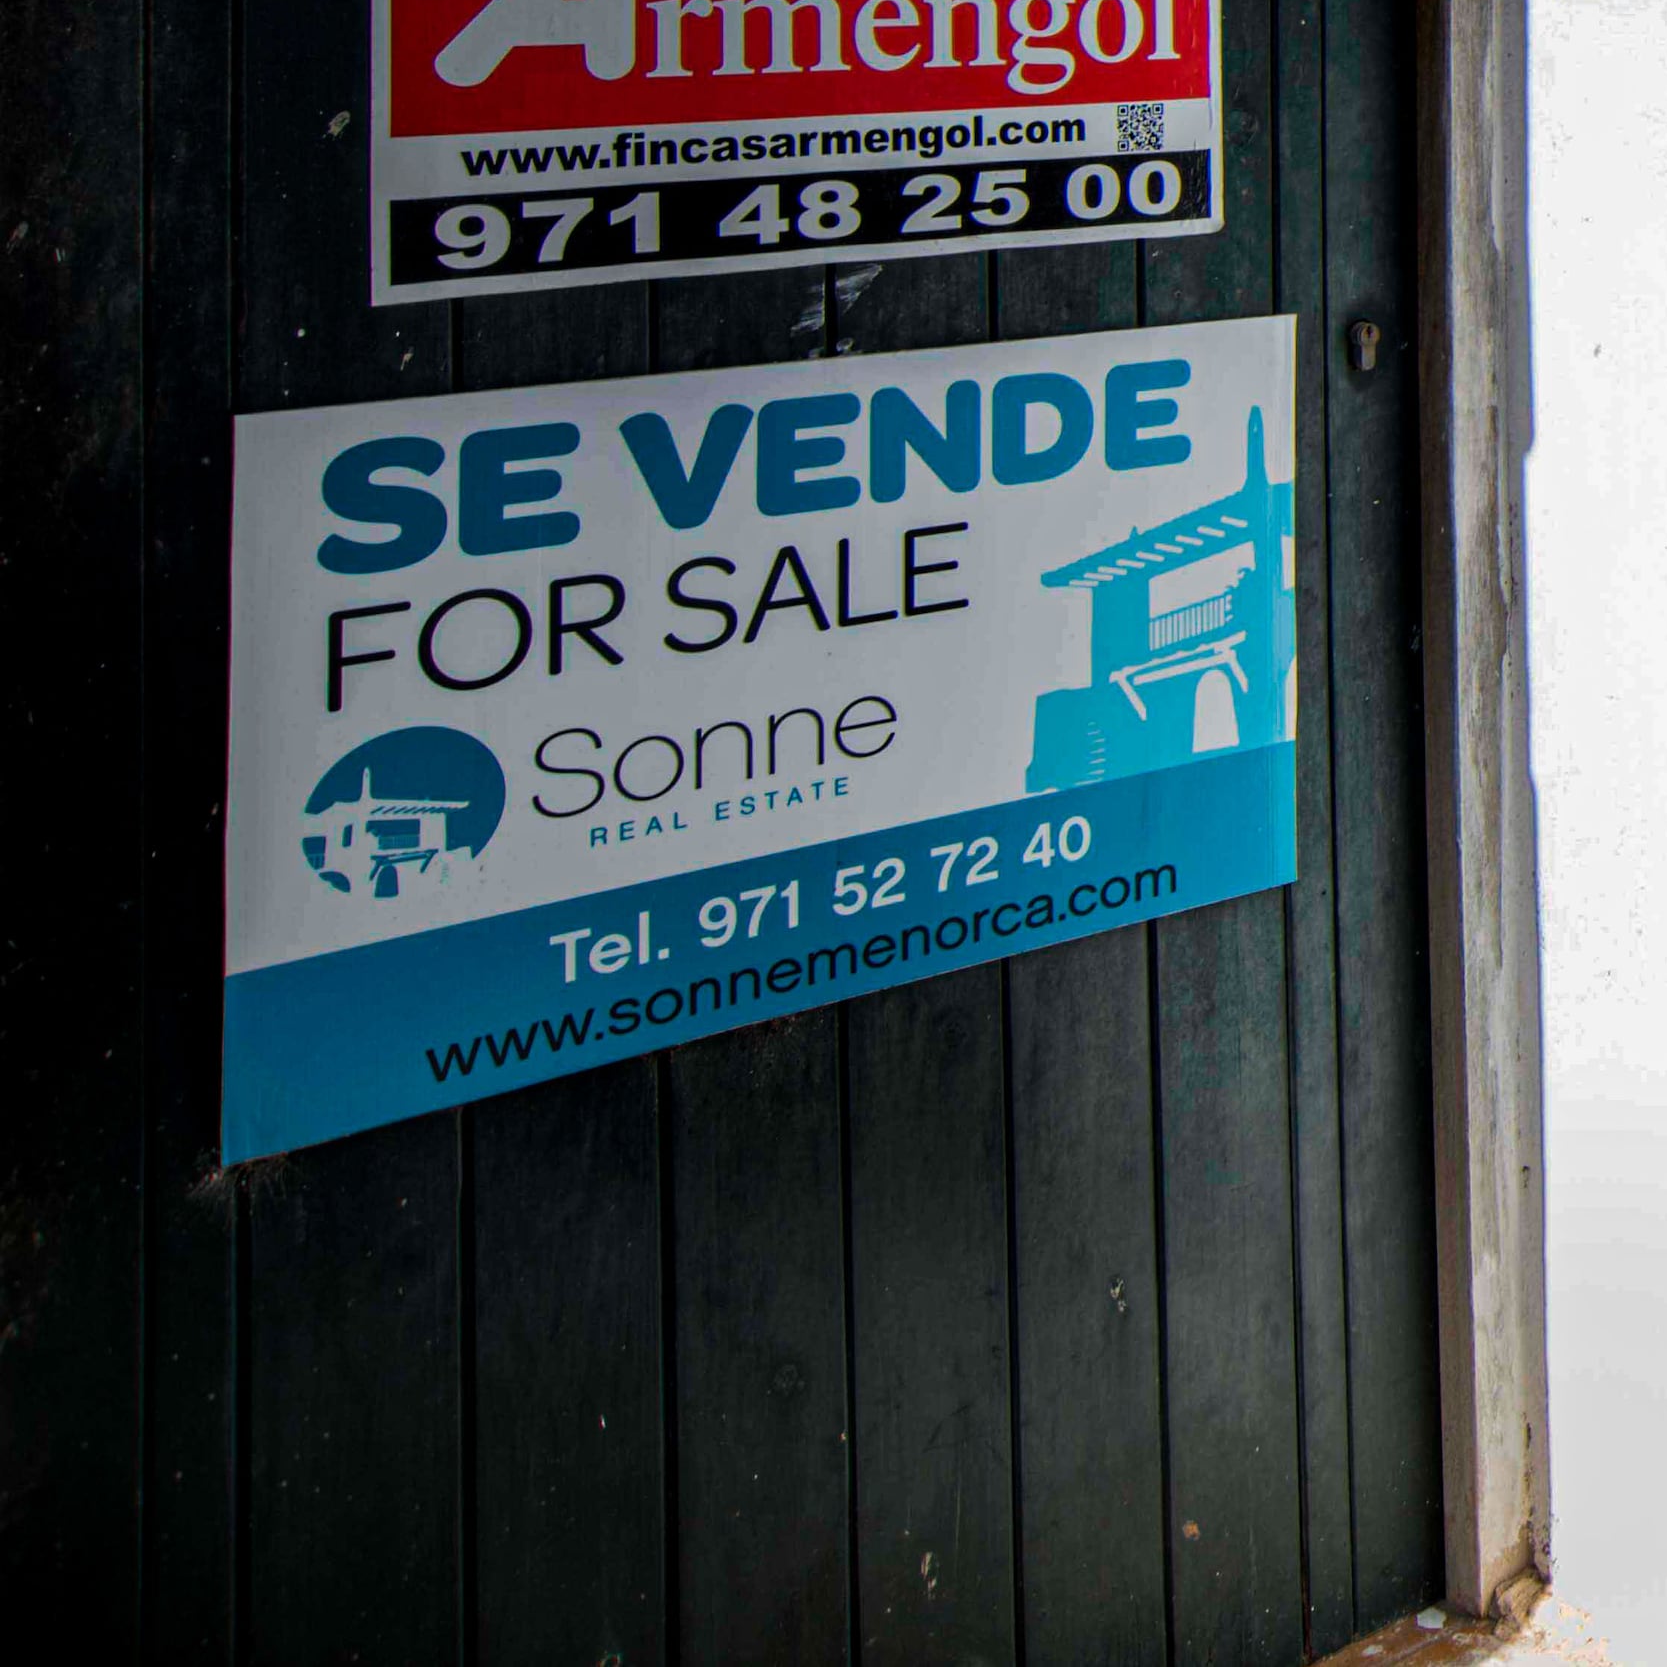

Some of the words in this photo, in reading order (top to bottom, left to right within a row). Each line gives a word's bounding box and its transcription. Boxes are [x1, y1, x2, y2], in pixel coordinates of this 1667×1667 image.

[434, 192, 662, 271] 971
[717, 180, 862, 245] 48
[900, 168, 1029, 235] 25
[1066, 160, 1182, 221] 00
[461, 114, 1087, 177] www.fincasarmengol.com
[316, 420, 581, 576] SE
[618, 358, 1192, 531] VENDE
[325, 573, 626, 714] FOR
[663, 521, 970, 656] SALE
[530, 694, 898, 819] Sonne
[590, 812, 687, 848] REAL
[714, 776, 852, 823] ESTATE
[424, 860, 1180, 1085] www.sonnemenorca.com
[549, 911, 670, 985] Tel.
[697, 879, 801, 951] 971
[830, 858, 907, 920] 52
[929, 836, 1000, 893] 72
[1021, 815, 1093, 869] 40
